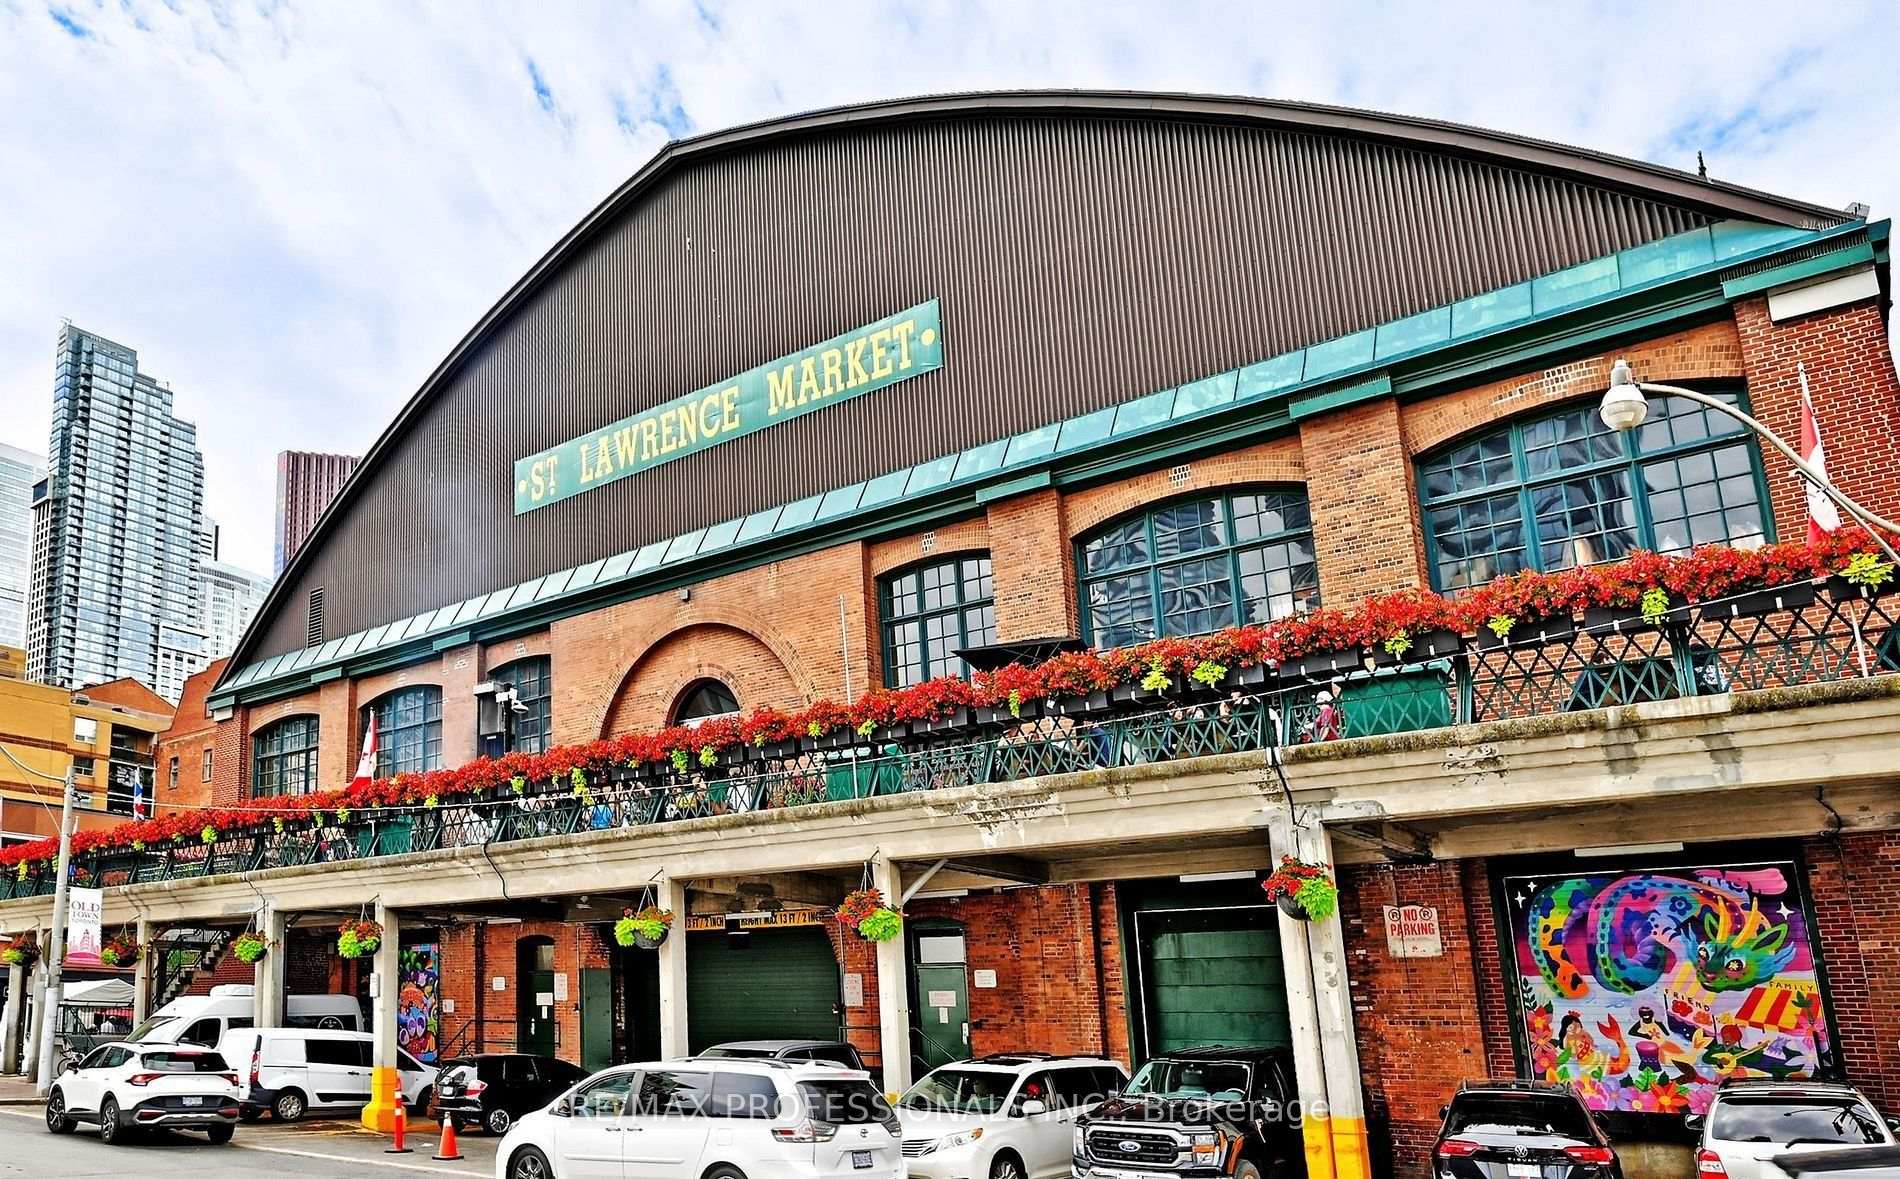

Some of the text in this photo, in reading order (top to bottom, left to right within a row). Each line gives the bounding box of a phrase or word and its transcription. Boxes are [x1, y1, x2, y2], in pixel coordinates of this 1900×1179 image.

[579, 386, 741, 484] LAWRENCE
[767, 319, 915, 416] MARKET
[71, 900, 100, 912] OLD
[780, 913, 788, 924] 13
[789, 912, 796, 924] FT
[1403, 908, 1418, 921] NO
[710, 916, 724, 927] INCH
[1390, 923, 1435, 936] PARKING
[1769, 981, 1815, 991] FAMILY
[1664, 988, 1710, 1011] FRIEND
